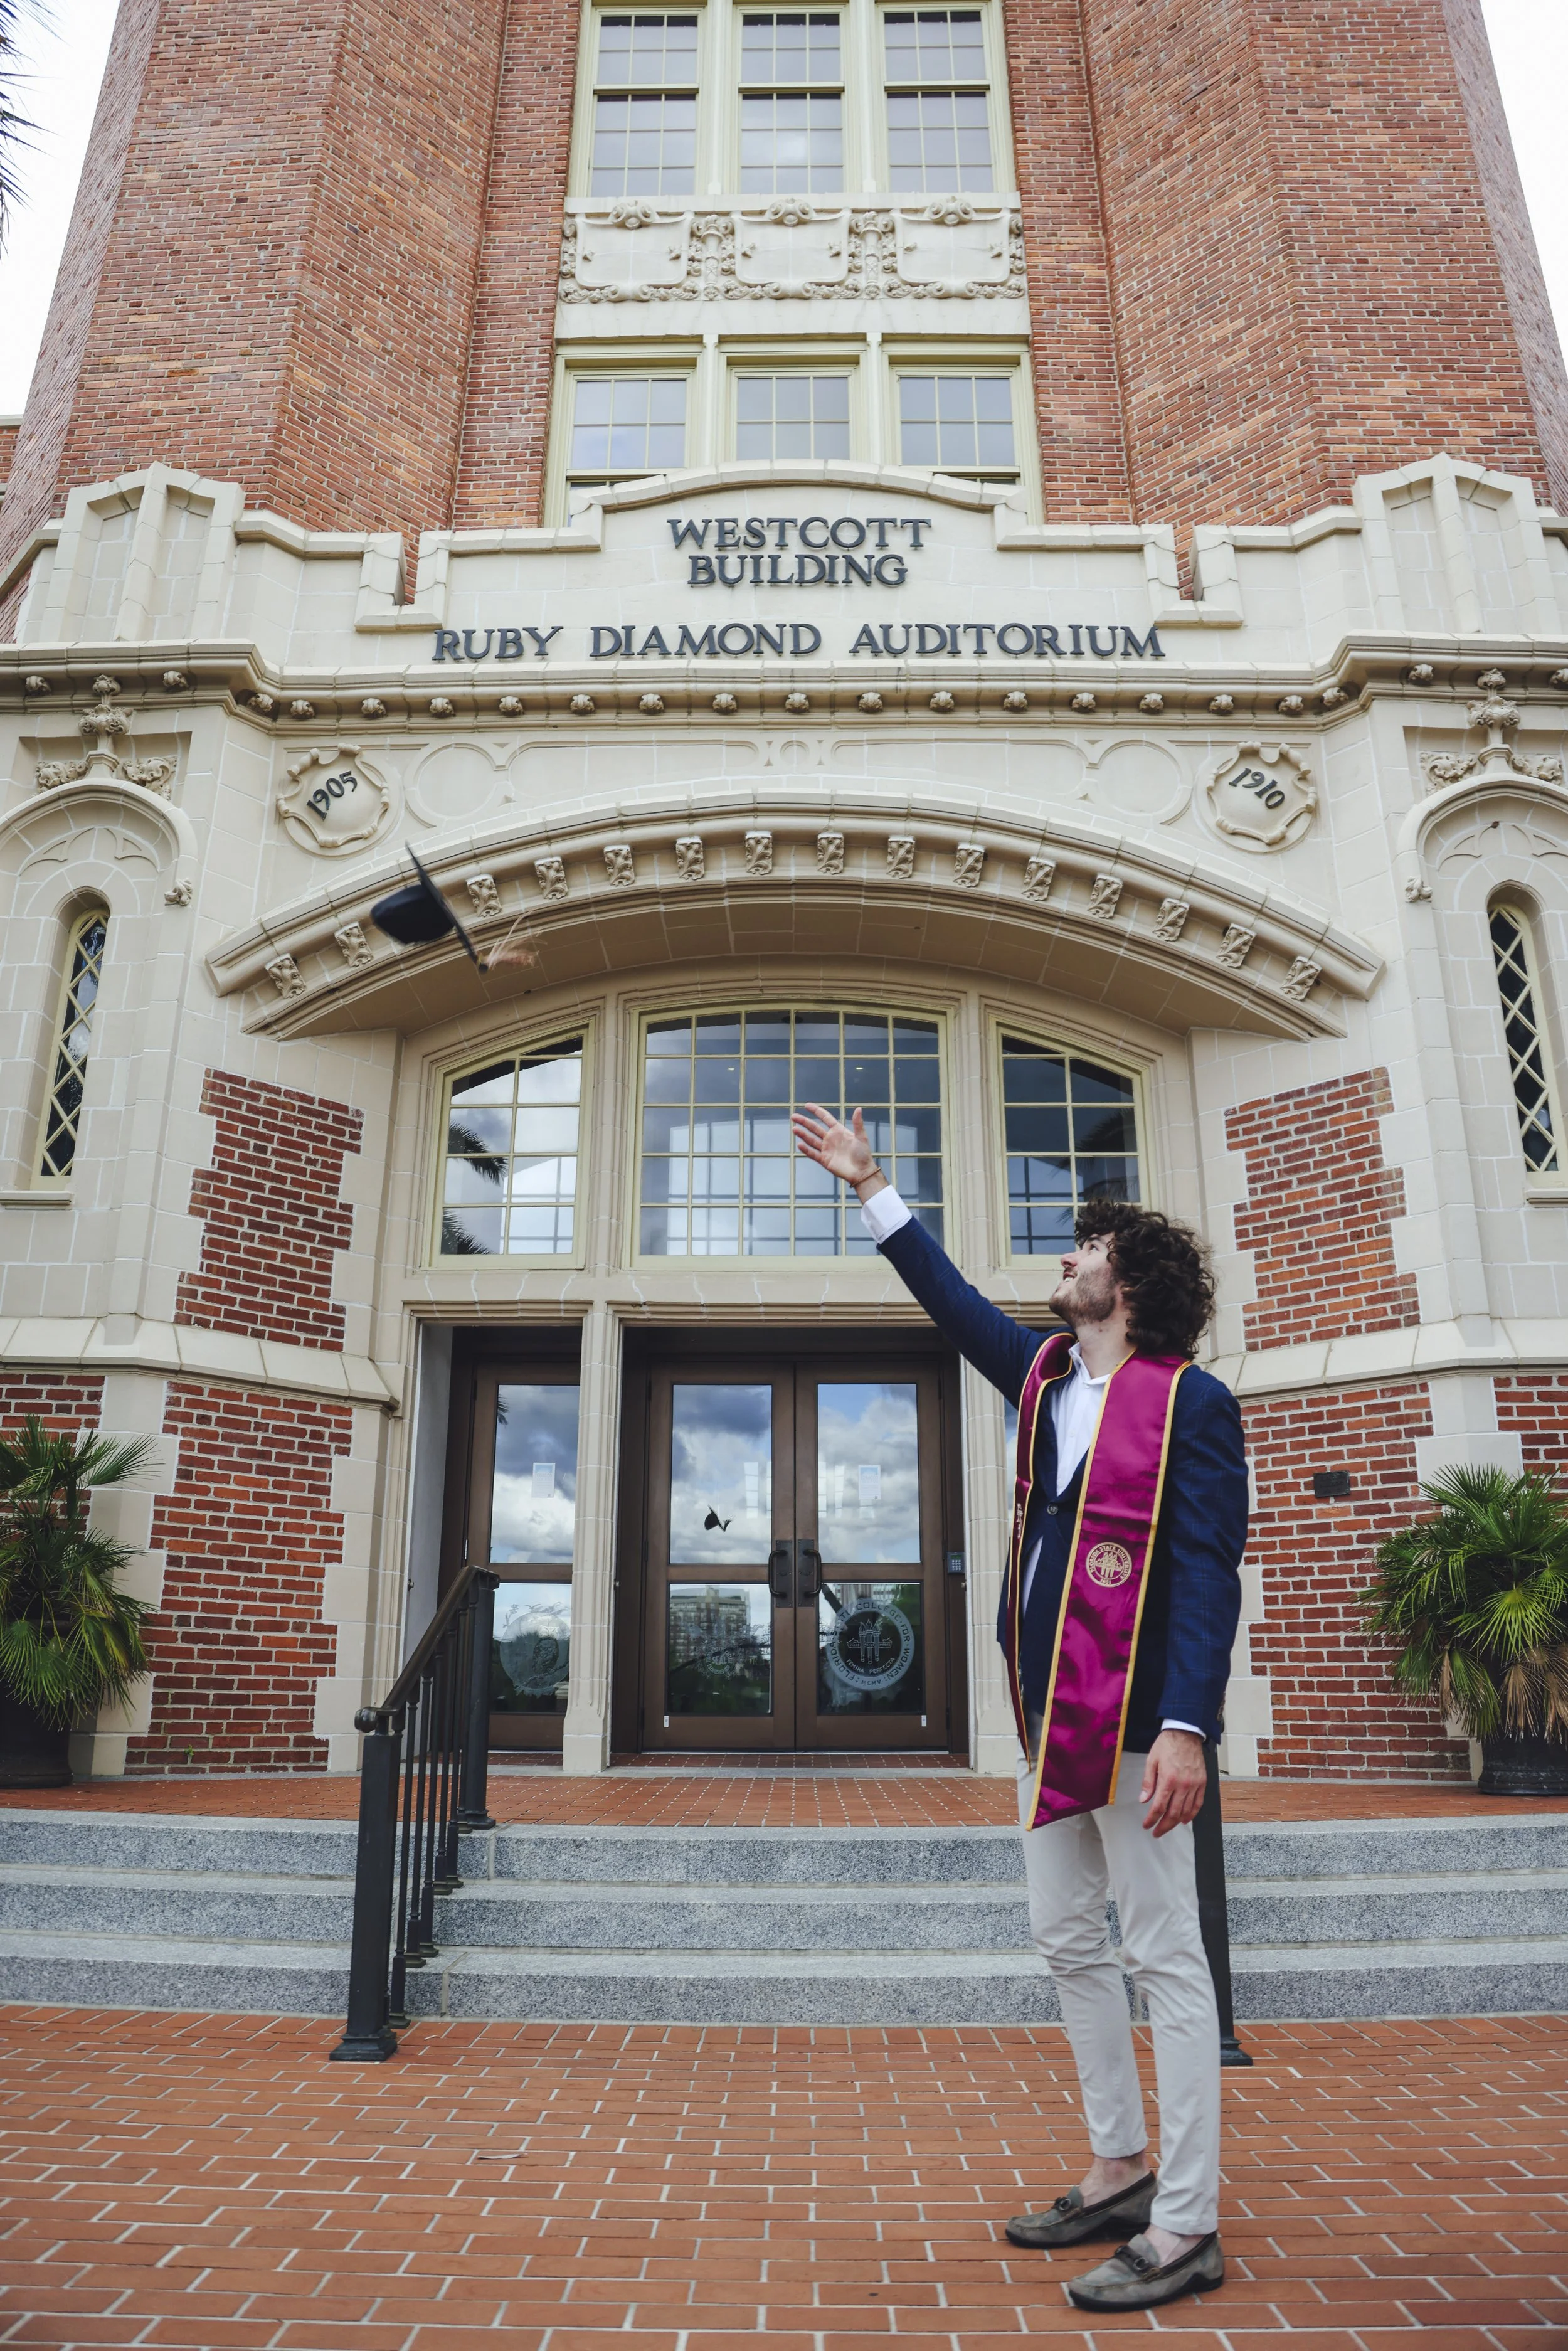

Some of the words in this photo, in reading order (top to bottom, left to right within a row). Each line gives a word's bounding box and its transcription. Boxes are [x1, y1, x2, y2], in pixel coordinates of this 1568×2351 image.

[667, 517, 932, 549] WESTCOTT
[687, 554, 908, 586] BUILDING
[431, 625, 564, 661] RUBY
[590, 623, 821, 657] DIAMOND
[849, 623, 1166, 657] AUDITORIUM
[306, 770, 358, 822] 1905
[1229, 767, 1285, 809] 1910
[856, 1602, 901, 1622] COLLEGE
[901, 1624, 910, 1642] FOR
[830, 1642, 856, 1681] FLORIDA
[846, 1659, 864, 1673] FEMINA
[869, 1658, 896, 1674] PERFECTA
[886, 1648, 910, 1680] WOMEN
